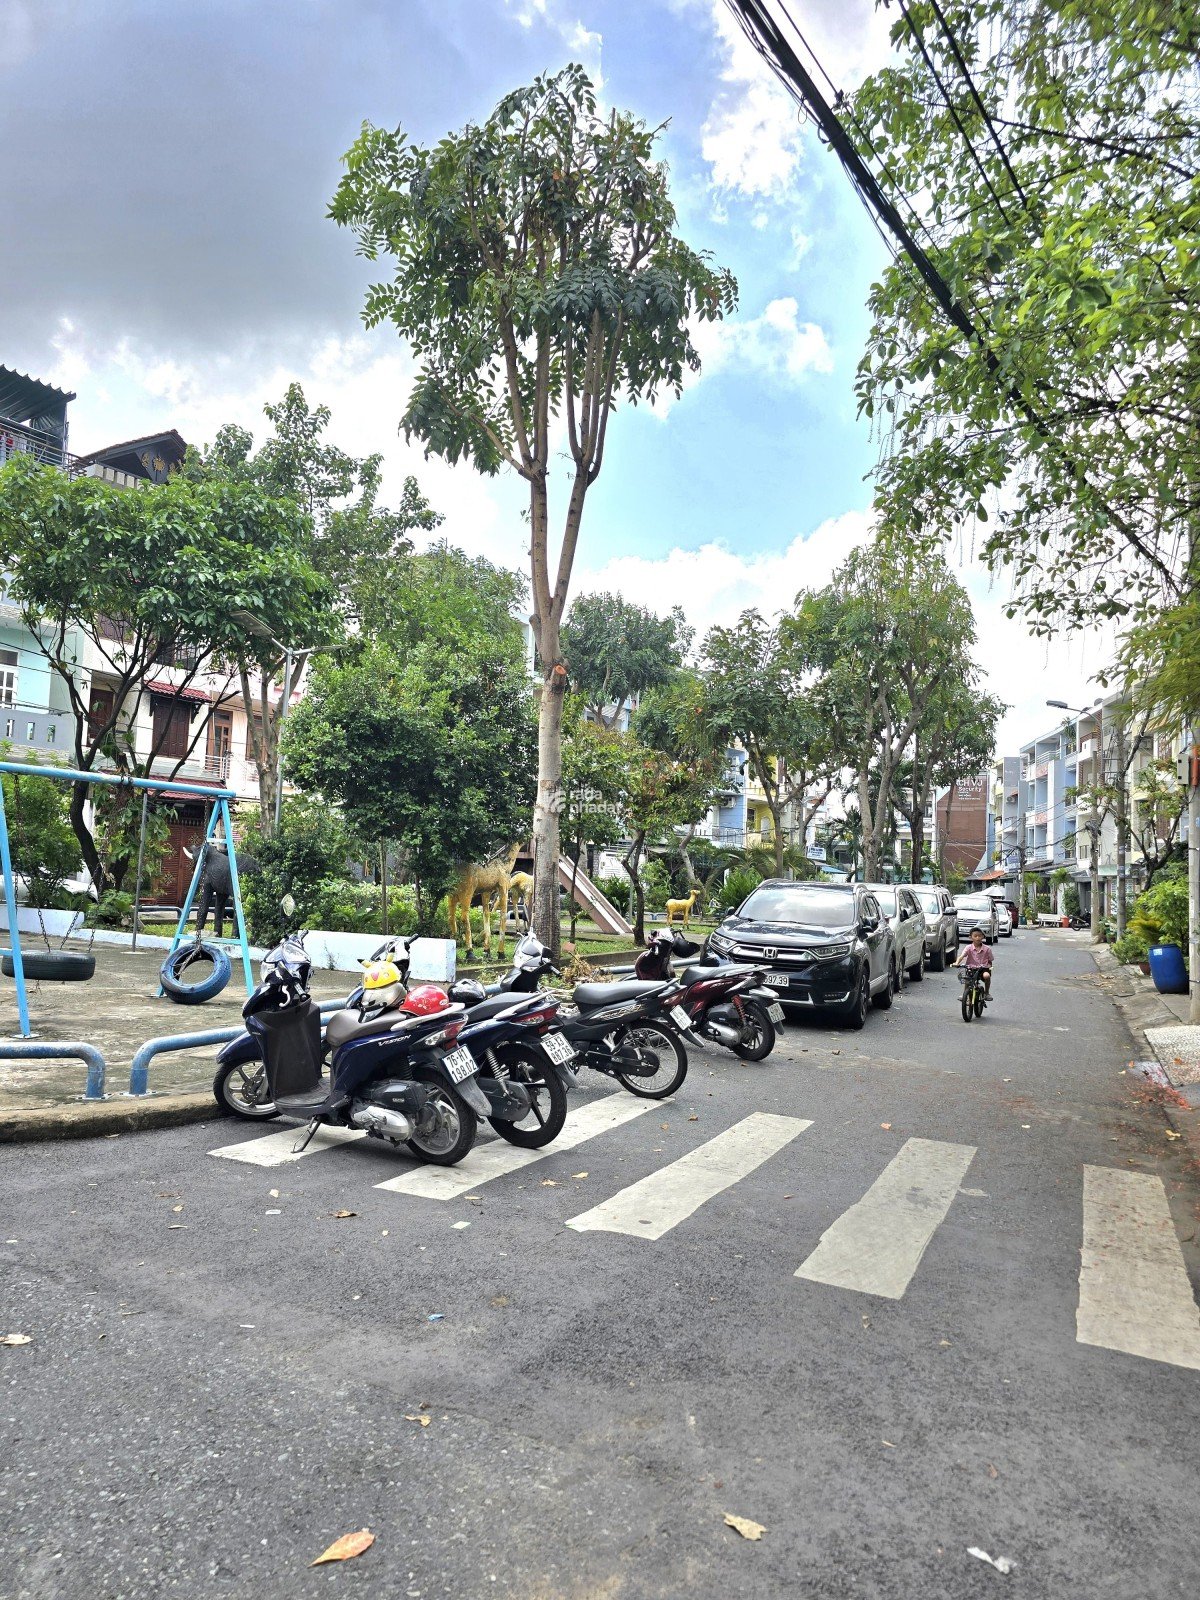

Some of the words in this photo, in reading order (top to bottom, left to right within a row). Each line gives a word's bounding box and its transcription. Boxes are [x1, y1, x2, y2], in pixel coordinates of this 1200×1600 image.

[378, 1034, 411, 1047] VISION
[447, 1048, 469, 1069] 76-H1
[452, 1059, 477, 1081] 198.02
